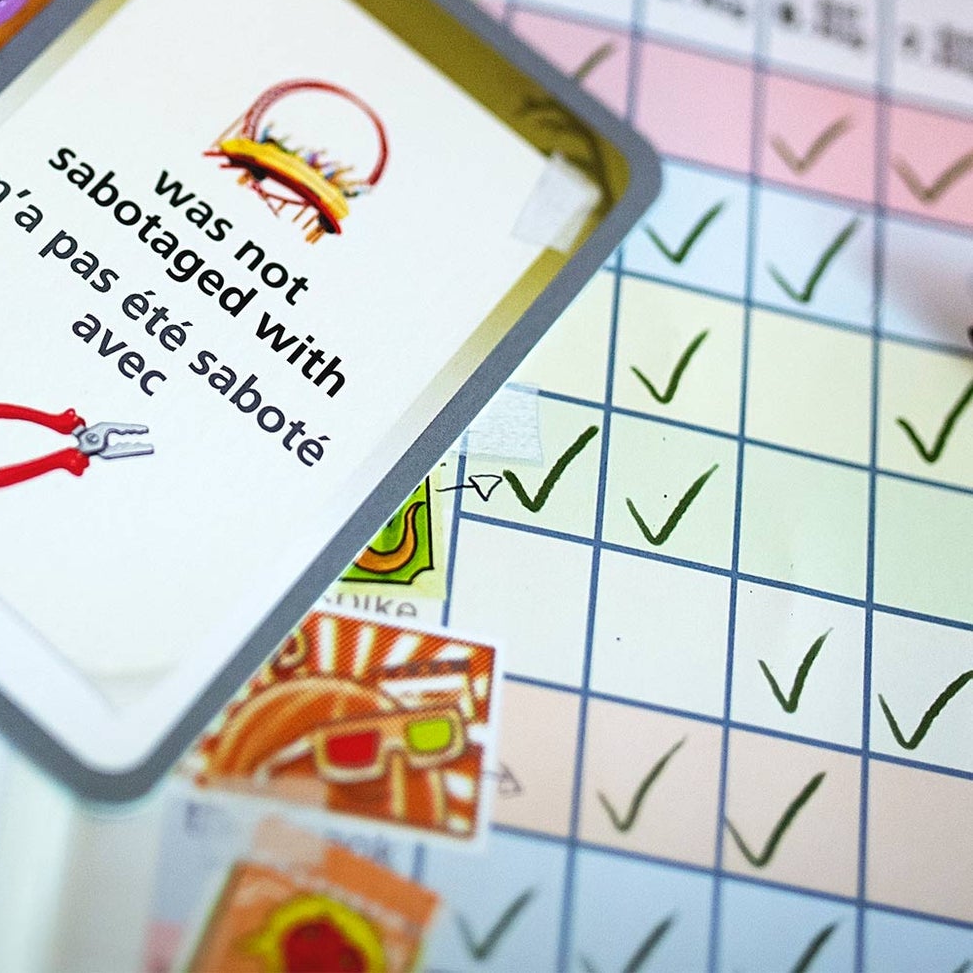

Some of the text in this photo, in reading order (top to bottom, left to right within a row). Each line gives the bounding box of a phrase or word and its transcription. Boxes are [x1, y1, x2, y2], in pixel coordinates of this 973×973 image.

[48, 146, 346, 399] sabotaged with
[154, 170, 309, 307] was not
[37, 229, 121, 294] pas
[121, 289, 194, 352] été
[187, 349, 331, 468] saboté
[71, 313, 168, 397] avec
